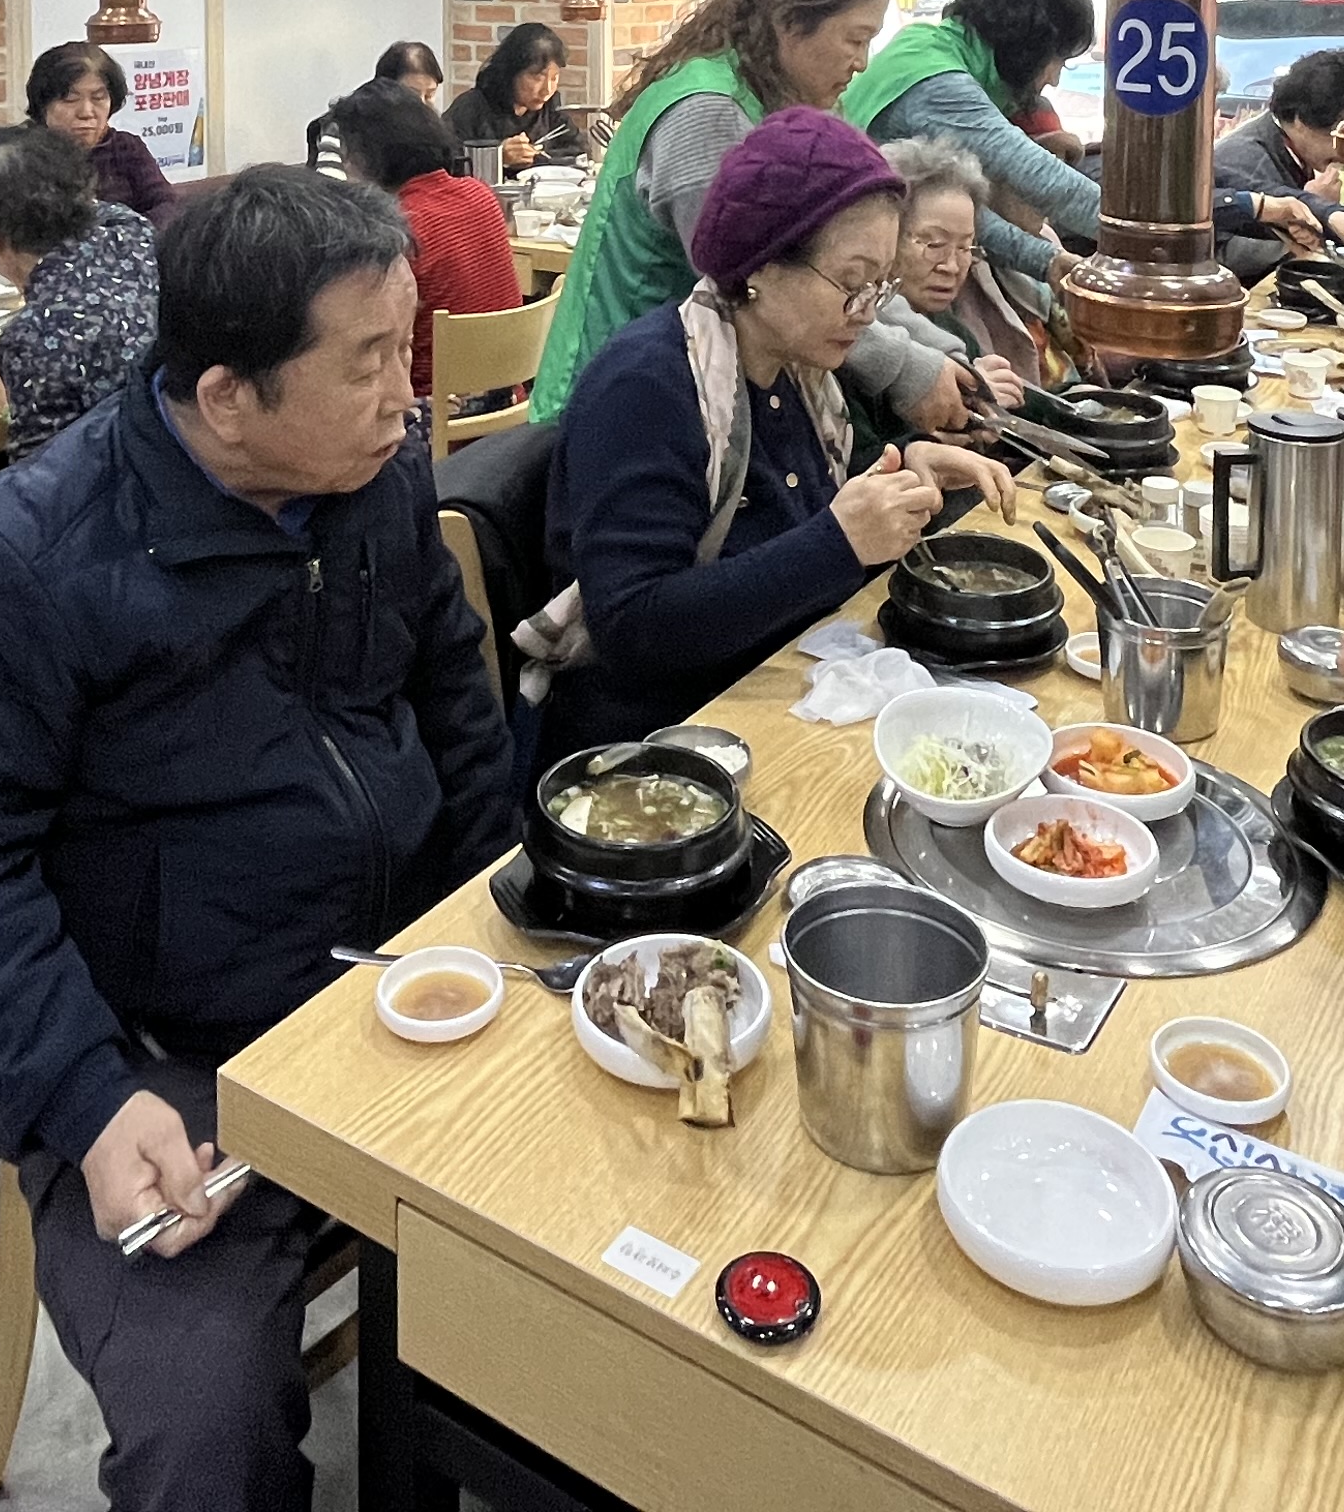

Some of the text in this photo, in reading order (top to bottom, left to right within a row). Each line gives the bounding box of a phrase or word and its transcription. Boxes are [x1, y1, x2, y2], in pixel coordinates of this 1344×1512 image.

[1116, 18, 1197, 96] 25
[134, 69, 189, 91] 양념게장
[134, 89, 190, 112] 포장판매
